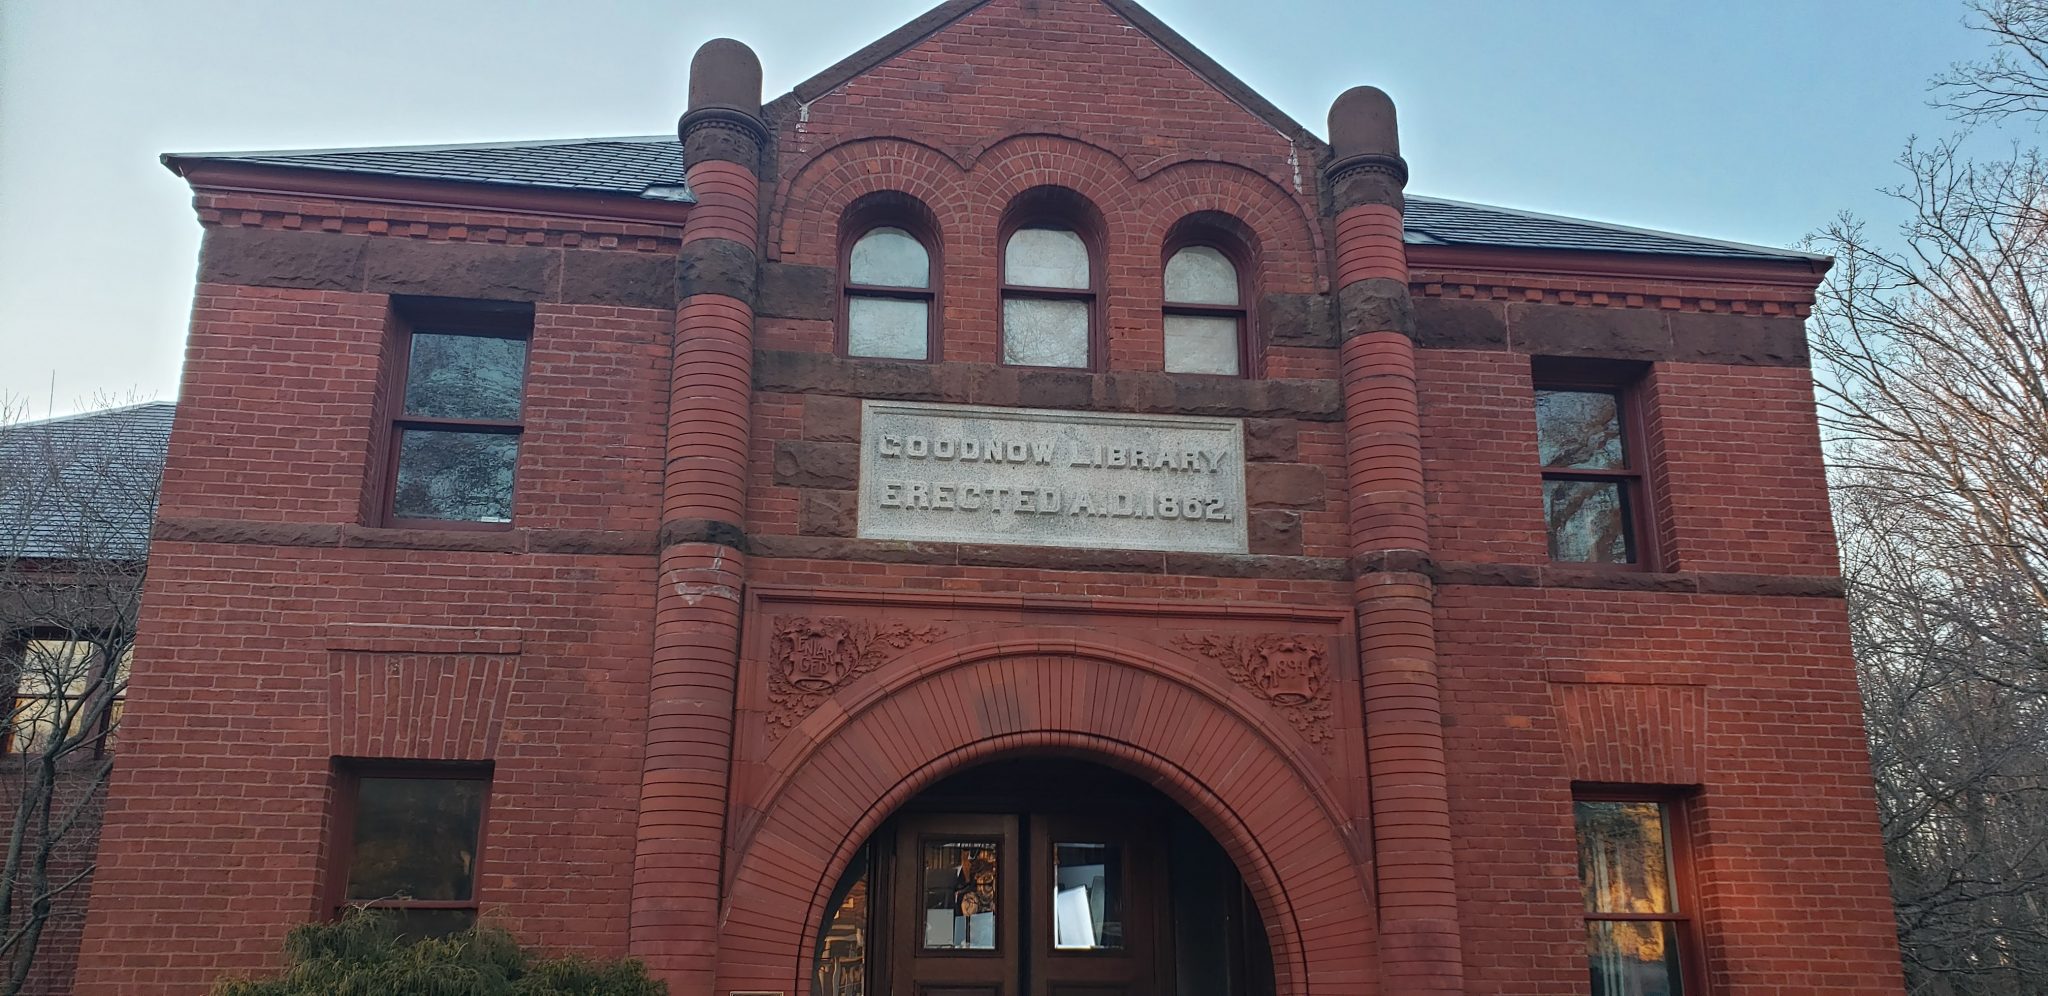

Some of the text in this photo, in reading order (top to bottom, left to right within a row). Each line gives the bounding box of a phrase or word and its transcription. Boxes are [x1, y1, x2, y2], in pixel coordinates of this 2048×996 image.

[878, 435, 1228, 474] GOODNOW LIBRARY
[879, 482, 1063, 516] ERECTED
